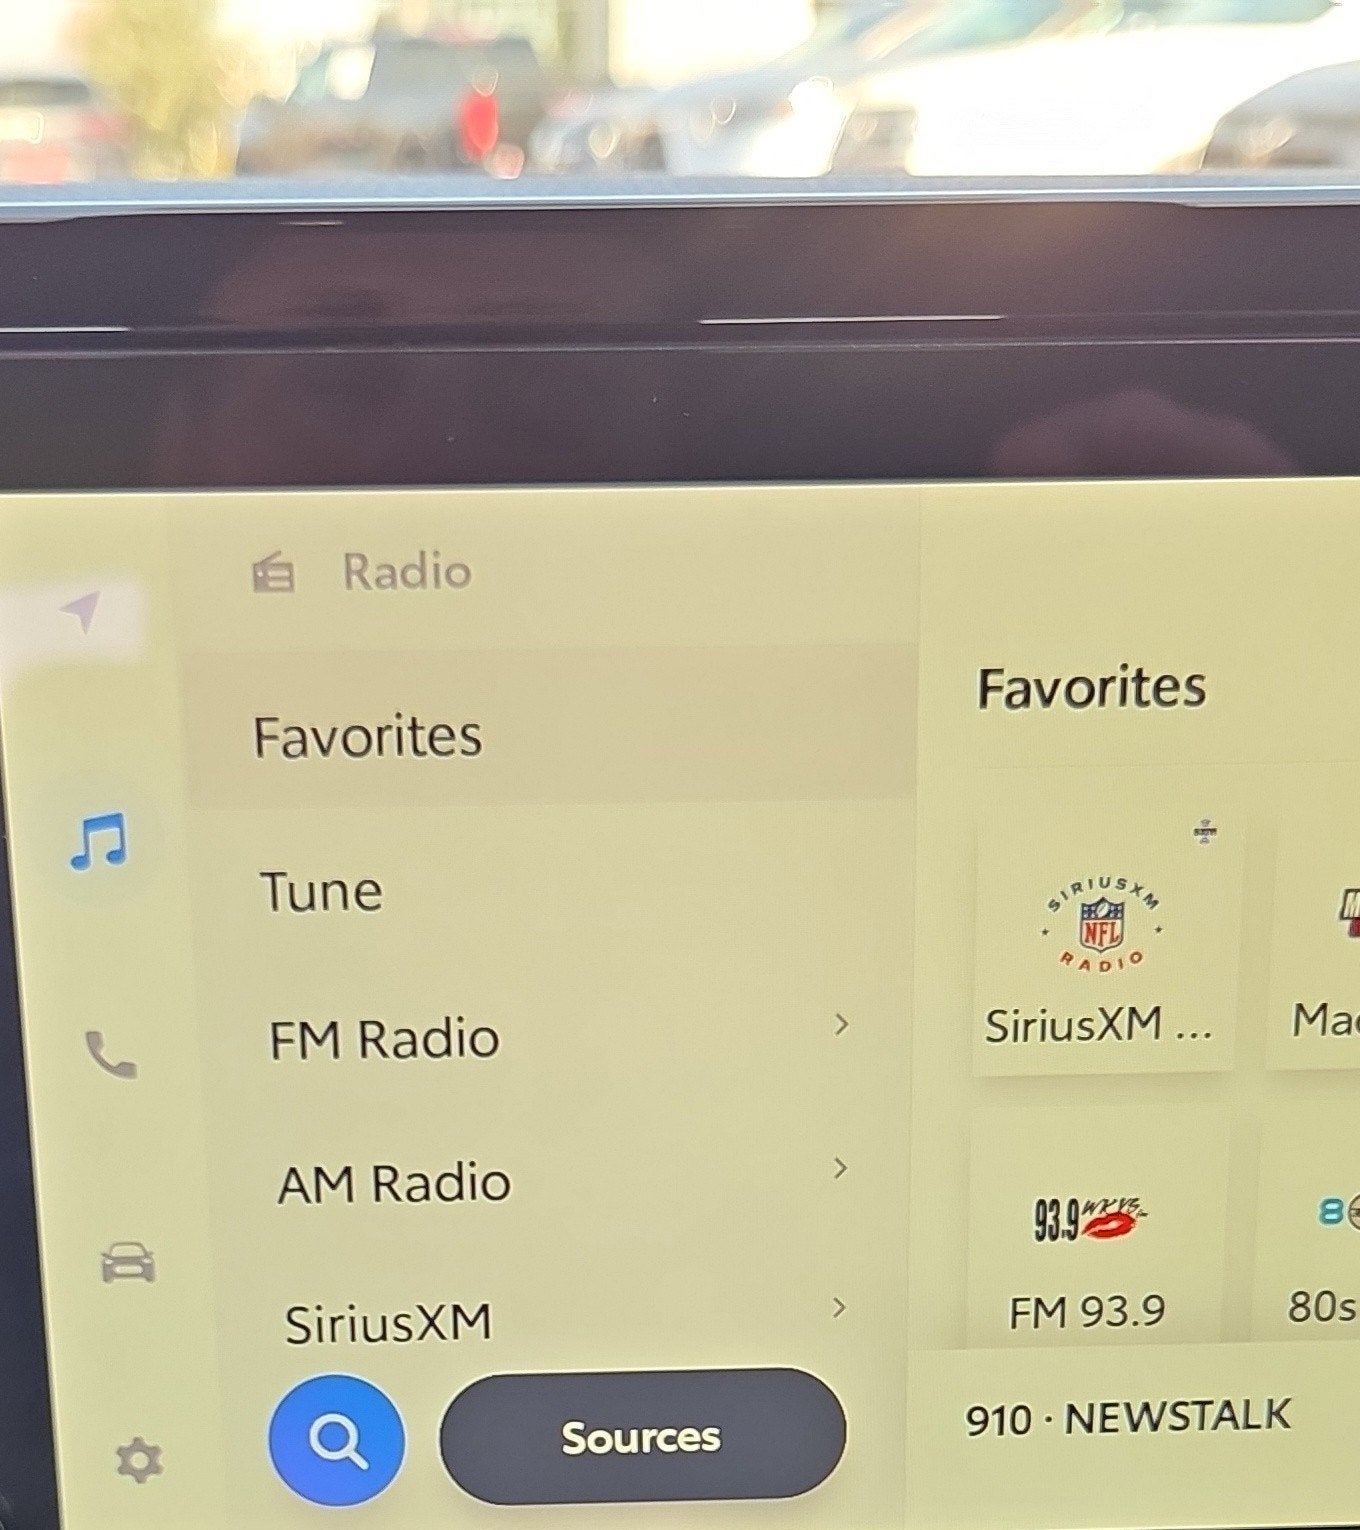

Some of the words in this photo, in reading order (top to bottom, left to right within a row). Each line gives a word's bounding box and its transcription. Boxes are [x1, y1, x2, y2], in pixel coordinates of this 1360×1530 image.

[344, 549, 472, 591] Radio
[979, 662, 1206, 710] Favorites
[254, 711, 482, 759] Favorites
[259, 871, 382, 913] Tune
[1046, 875, 1161, 914] SIRIUSXM
[1084, 921, 1121, 947] NFL
[1059, 951, 1143, 973] RADIO
[271, 1020, 340, 1060] FM
[359, 1015, 499, 1060] Radio
[986, 1005, 1162, 1043] SiriusXM
[277, 1165, 354, 1205] AM
[373, 1160, 511, 1203] Radio
[1035, 1198, 1079, 1242] 93.9
[286, 1303, 490, 1345] SiriusXM
[1011, 1296, 1066, 1330] FM
[1081, 1294, 1166, 1328] 93.9
[1288, 1289, 1357, 1323] 80s
[966, 1404, 1032, 1437] 910
[1066, 1397, 1292, 1435] NEWSTALK
[562, 1421, 721, 1455] Sources
